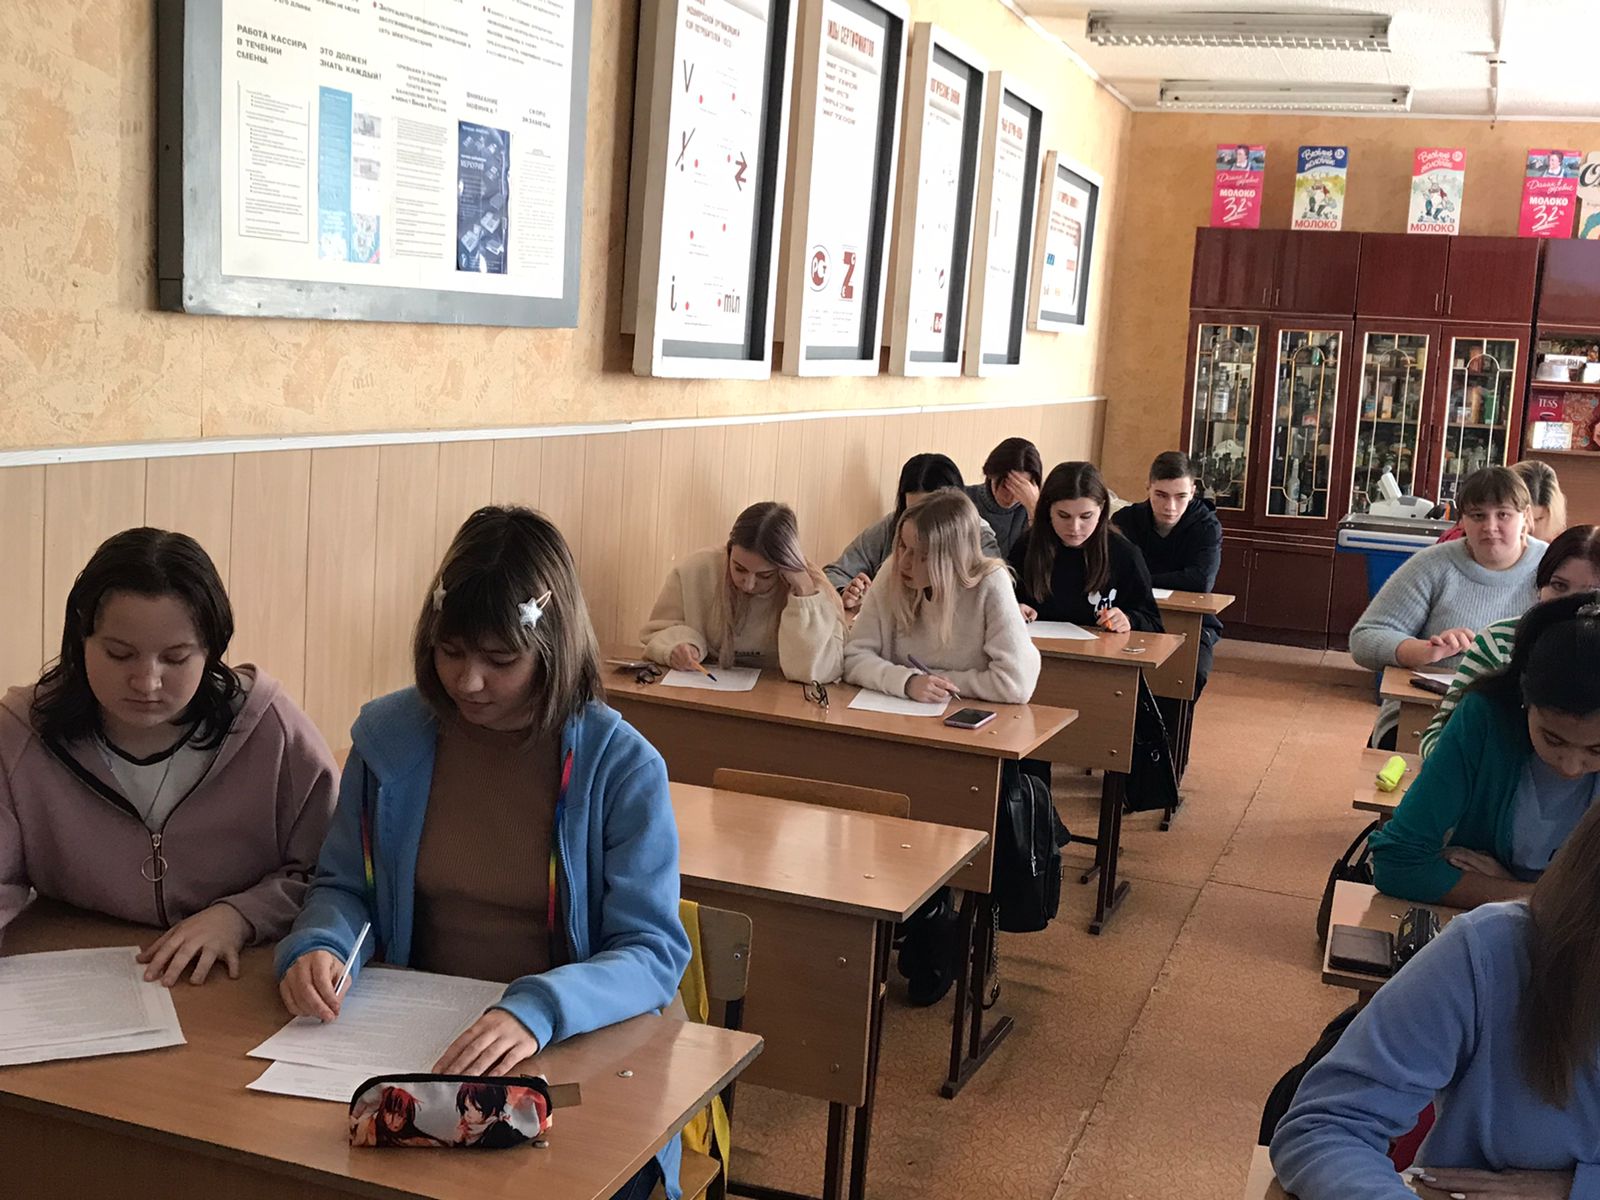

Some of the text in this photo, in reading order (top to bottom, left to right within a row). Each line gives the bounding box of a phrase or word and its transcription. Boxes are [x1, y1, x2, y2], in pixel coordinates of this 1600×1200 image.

[236, 24, 308, 50] РАБОТА КАССИРА
[236, 37, 282, 56] В ТЕЧЕНИИ
[319, 47, 367, 66] ЭТО ДОЛЖЕН
[319, 59, 343, 72] ЗНАТЬ
[1219, 189, 1256, 198] МОЛОКО
[1529, 196, 1569, 206] МОЛОКО
[1294, 220, 1338, 229] МОЛОКО
[1410, 223, 1455, 232] МОЛОКО
